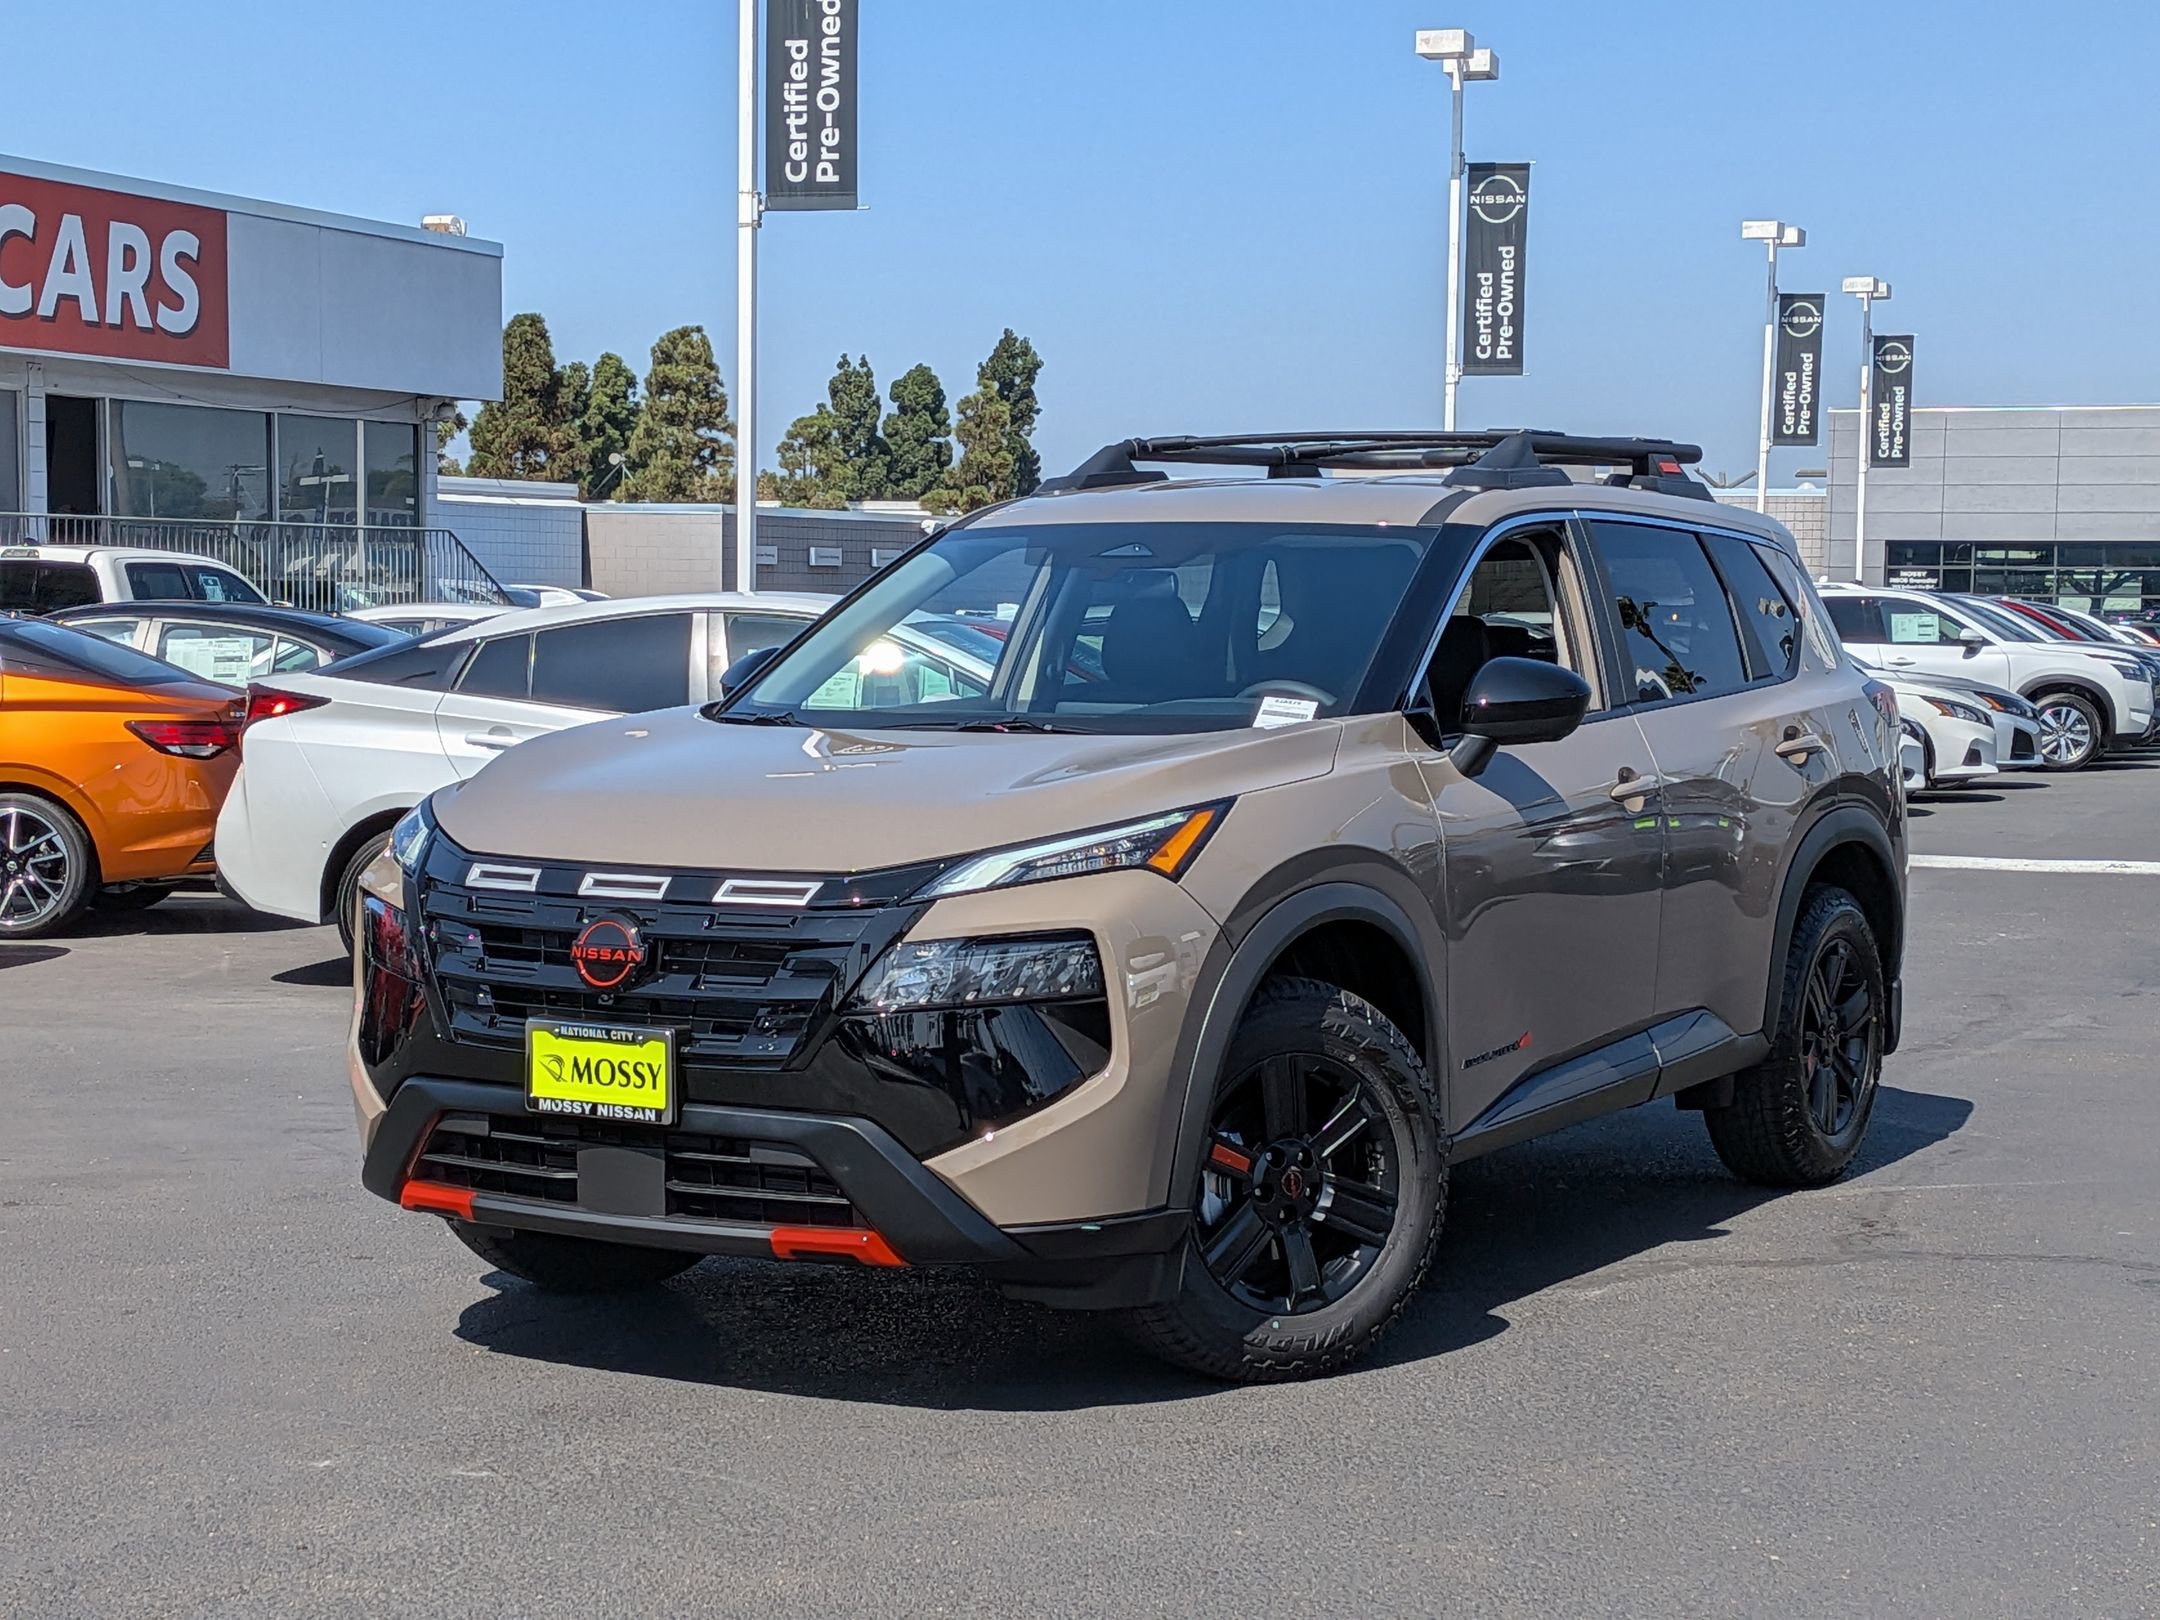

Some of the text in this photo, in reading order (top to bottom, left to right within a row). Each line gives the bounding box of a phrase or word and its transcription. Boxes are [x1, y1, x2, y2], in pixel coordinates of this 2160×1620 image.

[784, 39, 808, 183] Certified
[816, 0, 841, 182] Pre-Owned
[1470, 195, 1526, 204] NISSAN
[0, 203, 200, 336] CARS
[1475, 272, 1493, 359] Certified
[1496, 246, 1515, 359] Pre-Owned
[1781, 315, 1822, 324] NISSAN
[1875, 354, 1912, 362] NISSAN
[1782, 371, 1798, 435] Certified
[1797, 352, 1814, 435] Pre-Owned
[1891, 385, 1905, 458] Pre-Owned
[1878, 402, 1891, 458] Certified
[571, 947, 643, 962] NISSAN
[560, 1026, 634, 1041] NATIONAL CITY
[570, 1055, 662, 1090] MOSSY
[539, 1098, 656, 1121] MOSSY NISSAN
